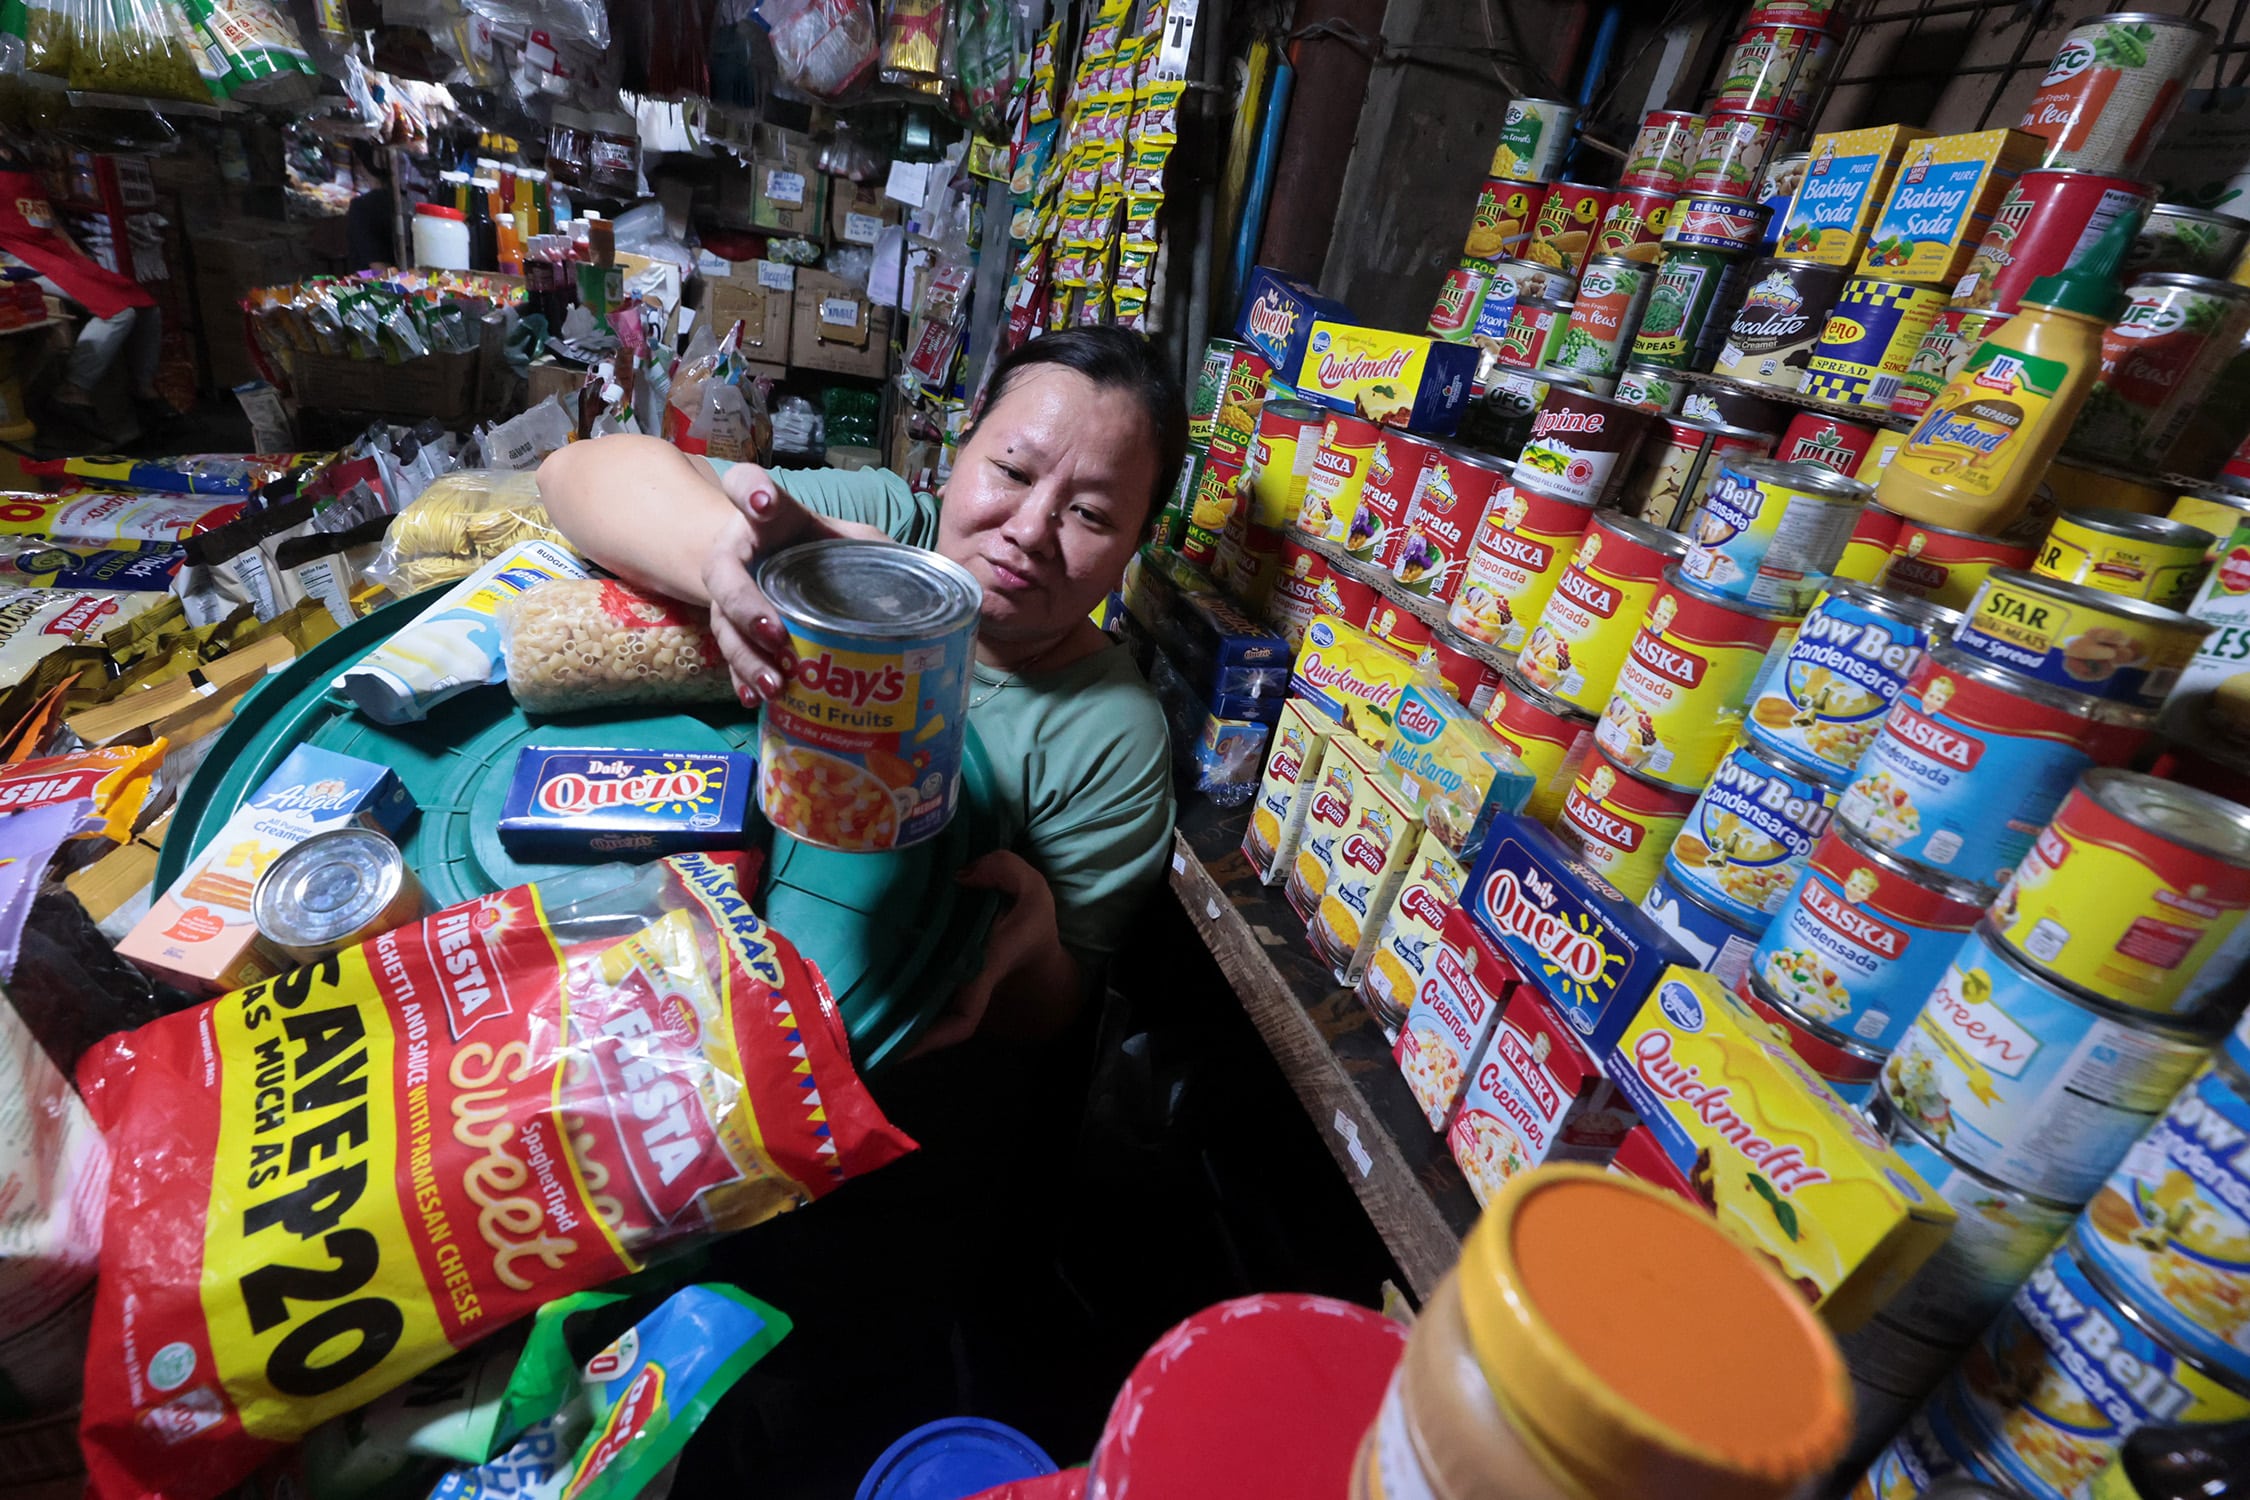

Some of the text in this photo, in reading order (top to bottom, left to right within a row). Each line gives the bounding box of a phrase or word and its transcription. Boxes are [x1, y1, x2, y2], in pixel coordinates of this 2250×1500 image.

[1849, 162, 1874, 174] PURE
[1949, 169, 1979, 182] PURE
[1803, 177, 1863, 204] Baking
[1894, 185, 1966, 214] Baking
[1541, 208, 1571, 227] JOLLY
[1604, 218, 1643, 237] JOLLY
[1694, 202, 1762, 220] RENO BRA
[1809, 202, 1853, 224] Soda
[1900, 213, 1954, 236] Soda
[1684, 234, 1720, 245] LIVER
[1582, 276, 1614, 293] UFC
[1250, 295, 1293, 341] Quezo
[1589, 308, 1617, 328] Peas
[1591, 302, 1609, 312] Fresh
[1730, 311, 1810, 337] hocolate
[1504, 356, 1532, 368] Mushroom
[1741, 339, 1779, 349] Creamer
[1317, 348, 1415, 390] Quickmelt!
[1815, 359, 1869, 377] SPREAD
[1882, 361, 1908, 374] SINCE
[1490, 387, 1532, 410] UFC
[1615, 384, 1645, 401] UFC
[1910, 408, 2009, 453] Mustard
[1970, 403, 2020, 427] PREPARED
[1316, 451, 1351, 474] ASKA
[1790, 443, 1855, 477] JOLLY
[1312, 471, 1341, 489] porada
[1363, 482, 1399, 512] orada
[1553, 482, 1571, 494] CREAM
[1571, 489, 1585, 497] MILK
[1721, 477, 1764, 515] Bell
[1415, 506, 1462, 543] porada
[125, 553, 173, 577] Thick
[536, 548, 569, 572] BUDGET
[1473, 550, 1527, 584] Evaporada
[1558, 567, 1612, 614] LASKA
[1550, 597, 1590, 629] aporada
[1986, 592, 2049, 631] STAR
[1632, 630, 1696, 683] LASKA
[1801, 608, 1921, 678] Cow Bel
[1988, 642, 2047, 669] Spread
[2004, 627, 2049, 651] MEATS
[776, 652, 905, 708] oday's
[1302, 651, 1403, 709] Quickmelt!
[783, 693, 894, 729] ixed Fruits
[1397, 699, 1441, 738] Eden
[803, 726, 819, 740] the
[586, 760, 636, 778] Daily
[1269, 751, 1299, 783] Cream
[1387, 739, 1464, 795] Melt Sarap
[0, 776, 83, 805] FIES
[254, 783, 361, 819] Angel
[539, 772, 704, 815] Quezo
[1714, 755, 1833, 837] Cow Bell
[280, 818, 312, 836] Purpose
[1312, 791, 1345, 828] Cream
[1704, 784, 1814, 857] Condensarap
[254, 821, 310, 844] Creame
[1342, 833, 1383, 874] Cream
[1523, 866, 1559, 909] Daily
[671, 853, 780, 986] PINASARAP
[1401, 885, 1444, 931] Cream
[1485, 871, 1600, 979] Quezo
[1801, 882, 1898, 955] ALASKA
[1793, 907, 1879, 973] Condensada
[437, 912, 491, 1017] FIESTA
[1437, 956, 1483, 1021] ALASKA
[1421, 978, 1472, 1051] Creamer
[1438, 989, 1469, 1026] All-Purpose
[272, 955, 369, 1177] SAVE
[1500, 1038, 1556, 1118] ALASKA
[242, 983, 286, 1190] AS MUCH AS
[601, 1006, 702, 1186] FIESTA
[1501, 1076, 1540, 1122] All-Purpose
[1478, 1062, 1544, 1151] Creamer
[1634, 1029, 1832, 1195] Quickmelt!
[401, 1003, 483, 1326] AND SAUCE WITH PARMESAN CHEESE
[449, 1038, 580, 1291] Sweet
[520, 1120, 580, 1233] SpaghetTipid
[2072, 1309, 2197, 1422] Bell
